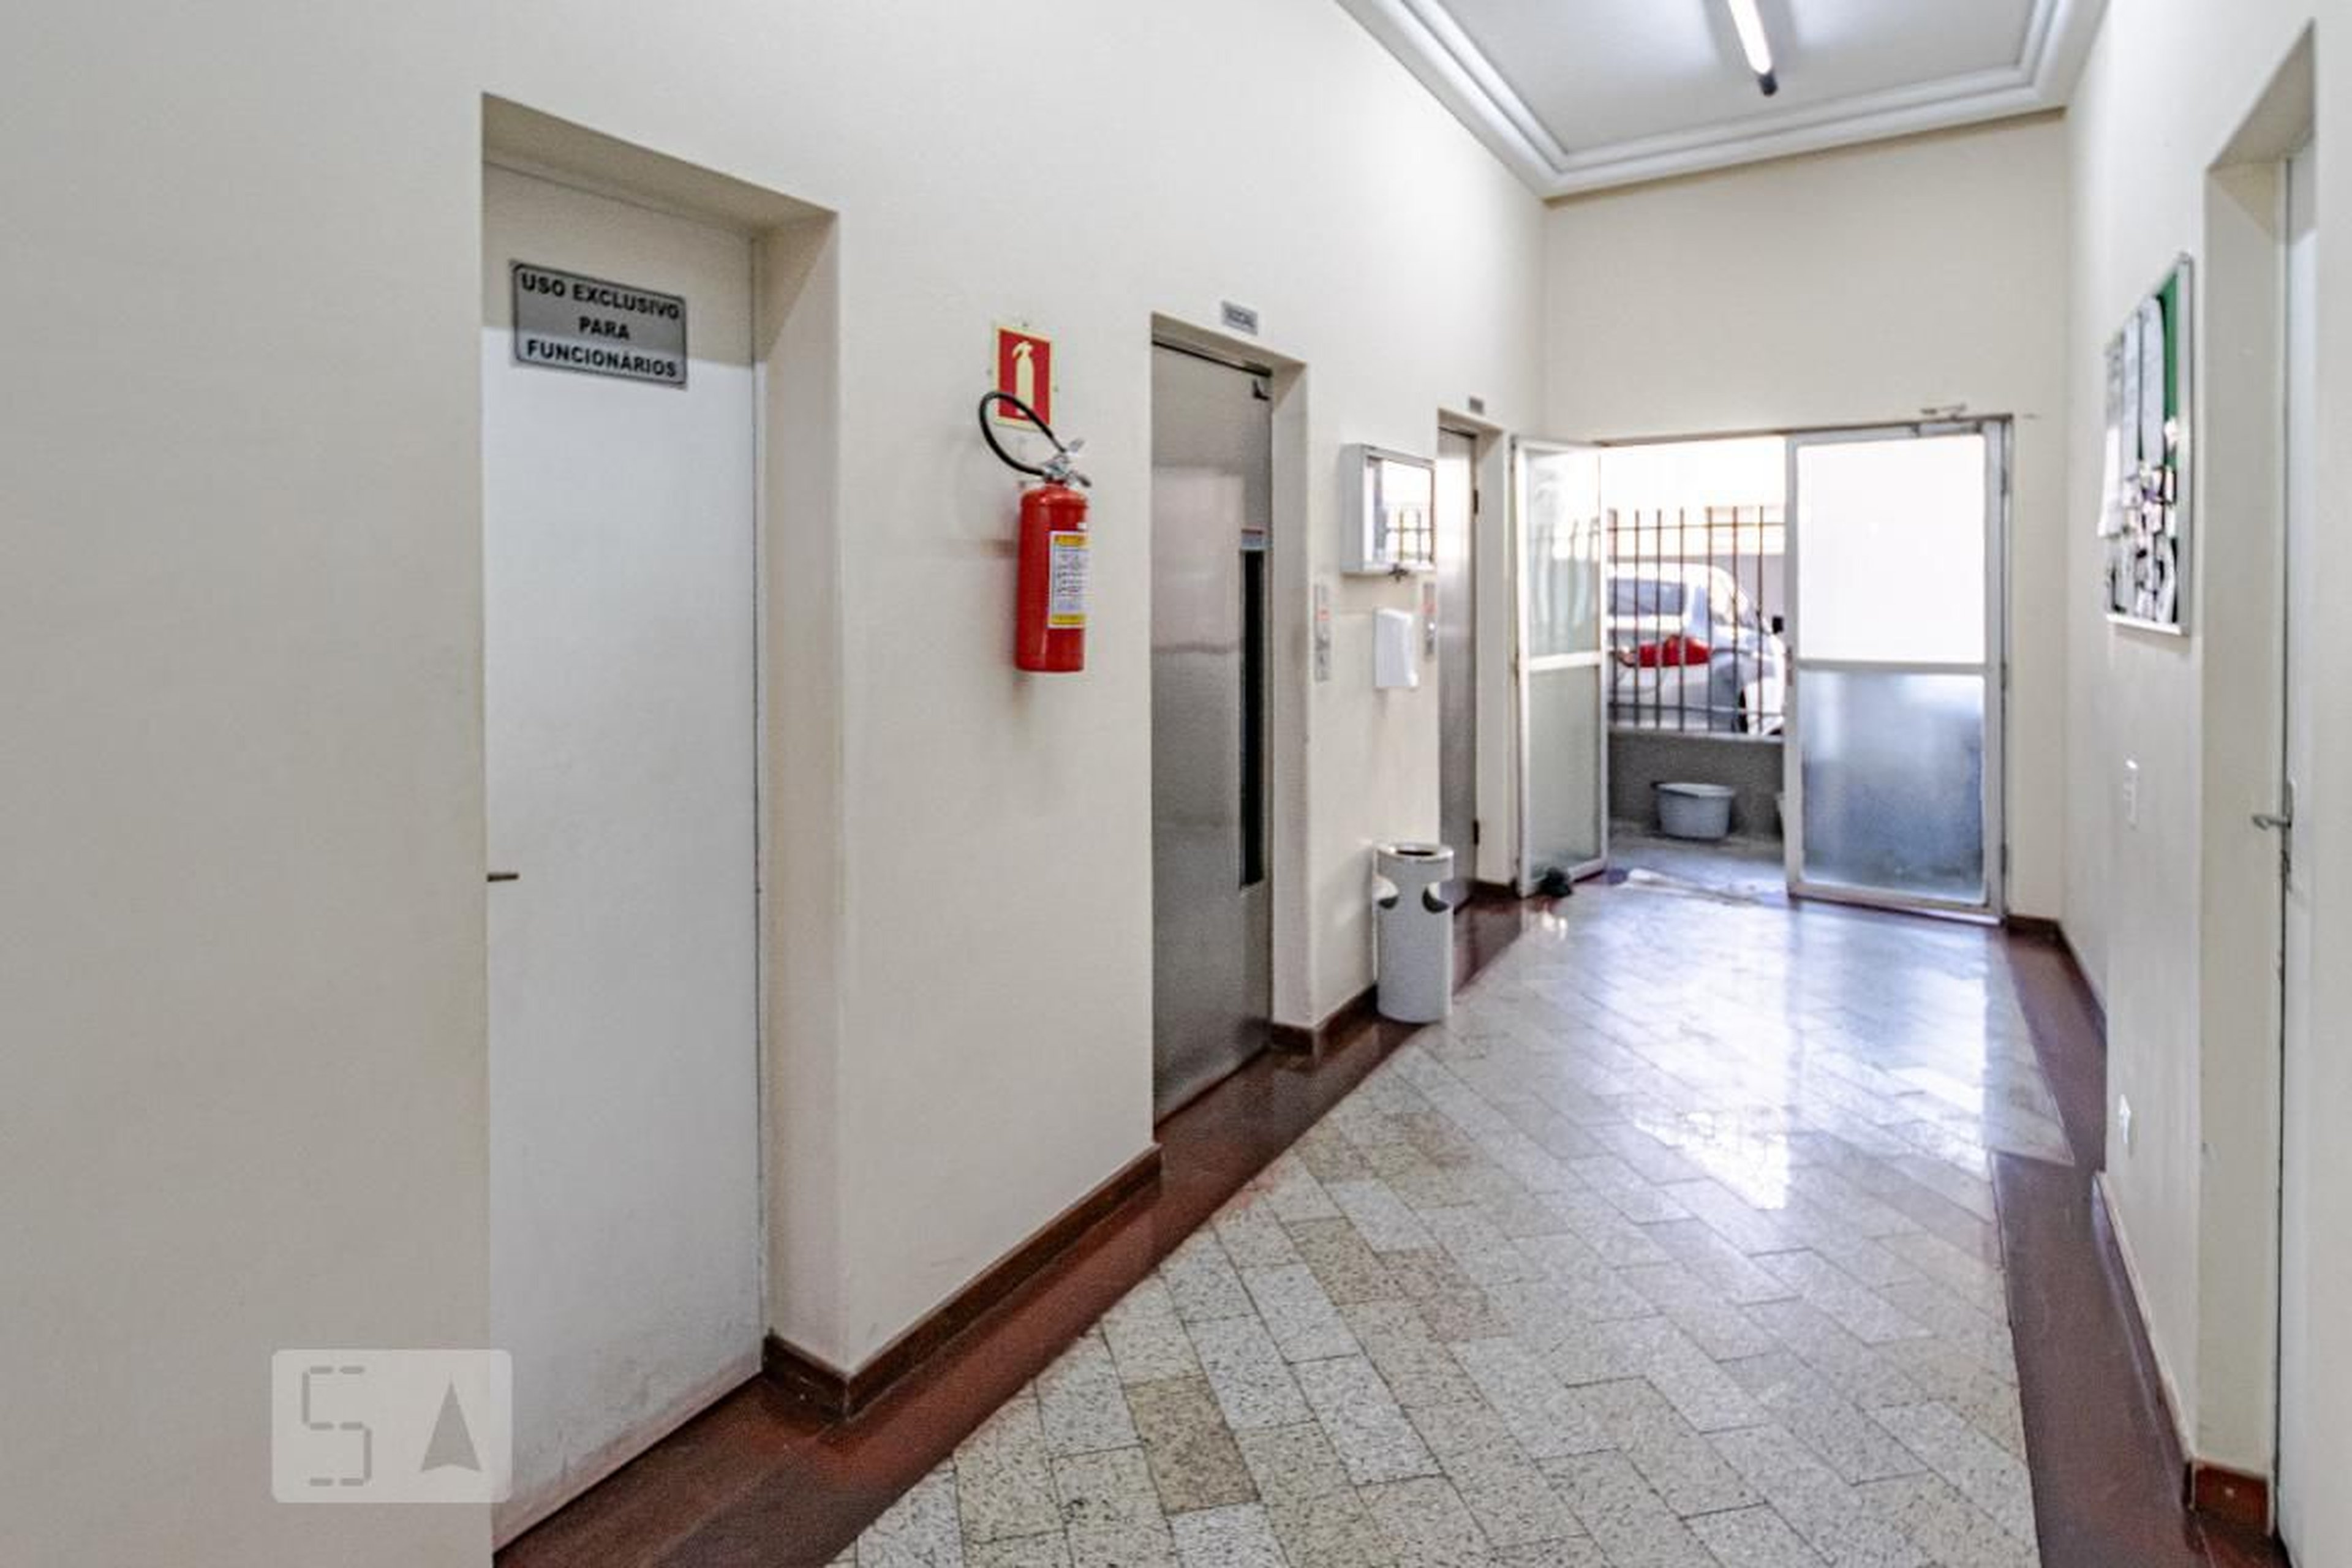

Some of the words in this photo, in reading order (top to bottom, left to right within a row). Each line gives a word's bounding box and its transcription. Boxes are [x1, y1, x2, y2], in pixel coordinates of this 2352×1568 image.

[522, 273, 565, 296] USO
[573, 284, 679, 319] EXCLUSIVO
[578, 317, 630, 339] PARA
[527, 339, 676, 377] FUNCIONÁRIOS
